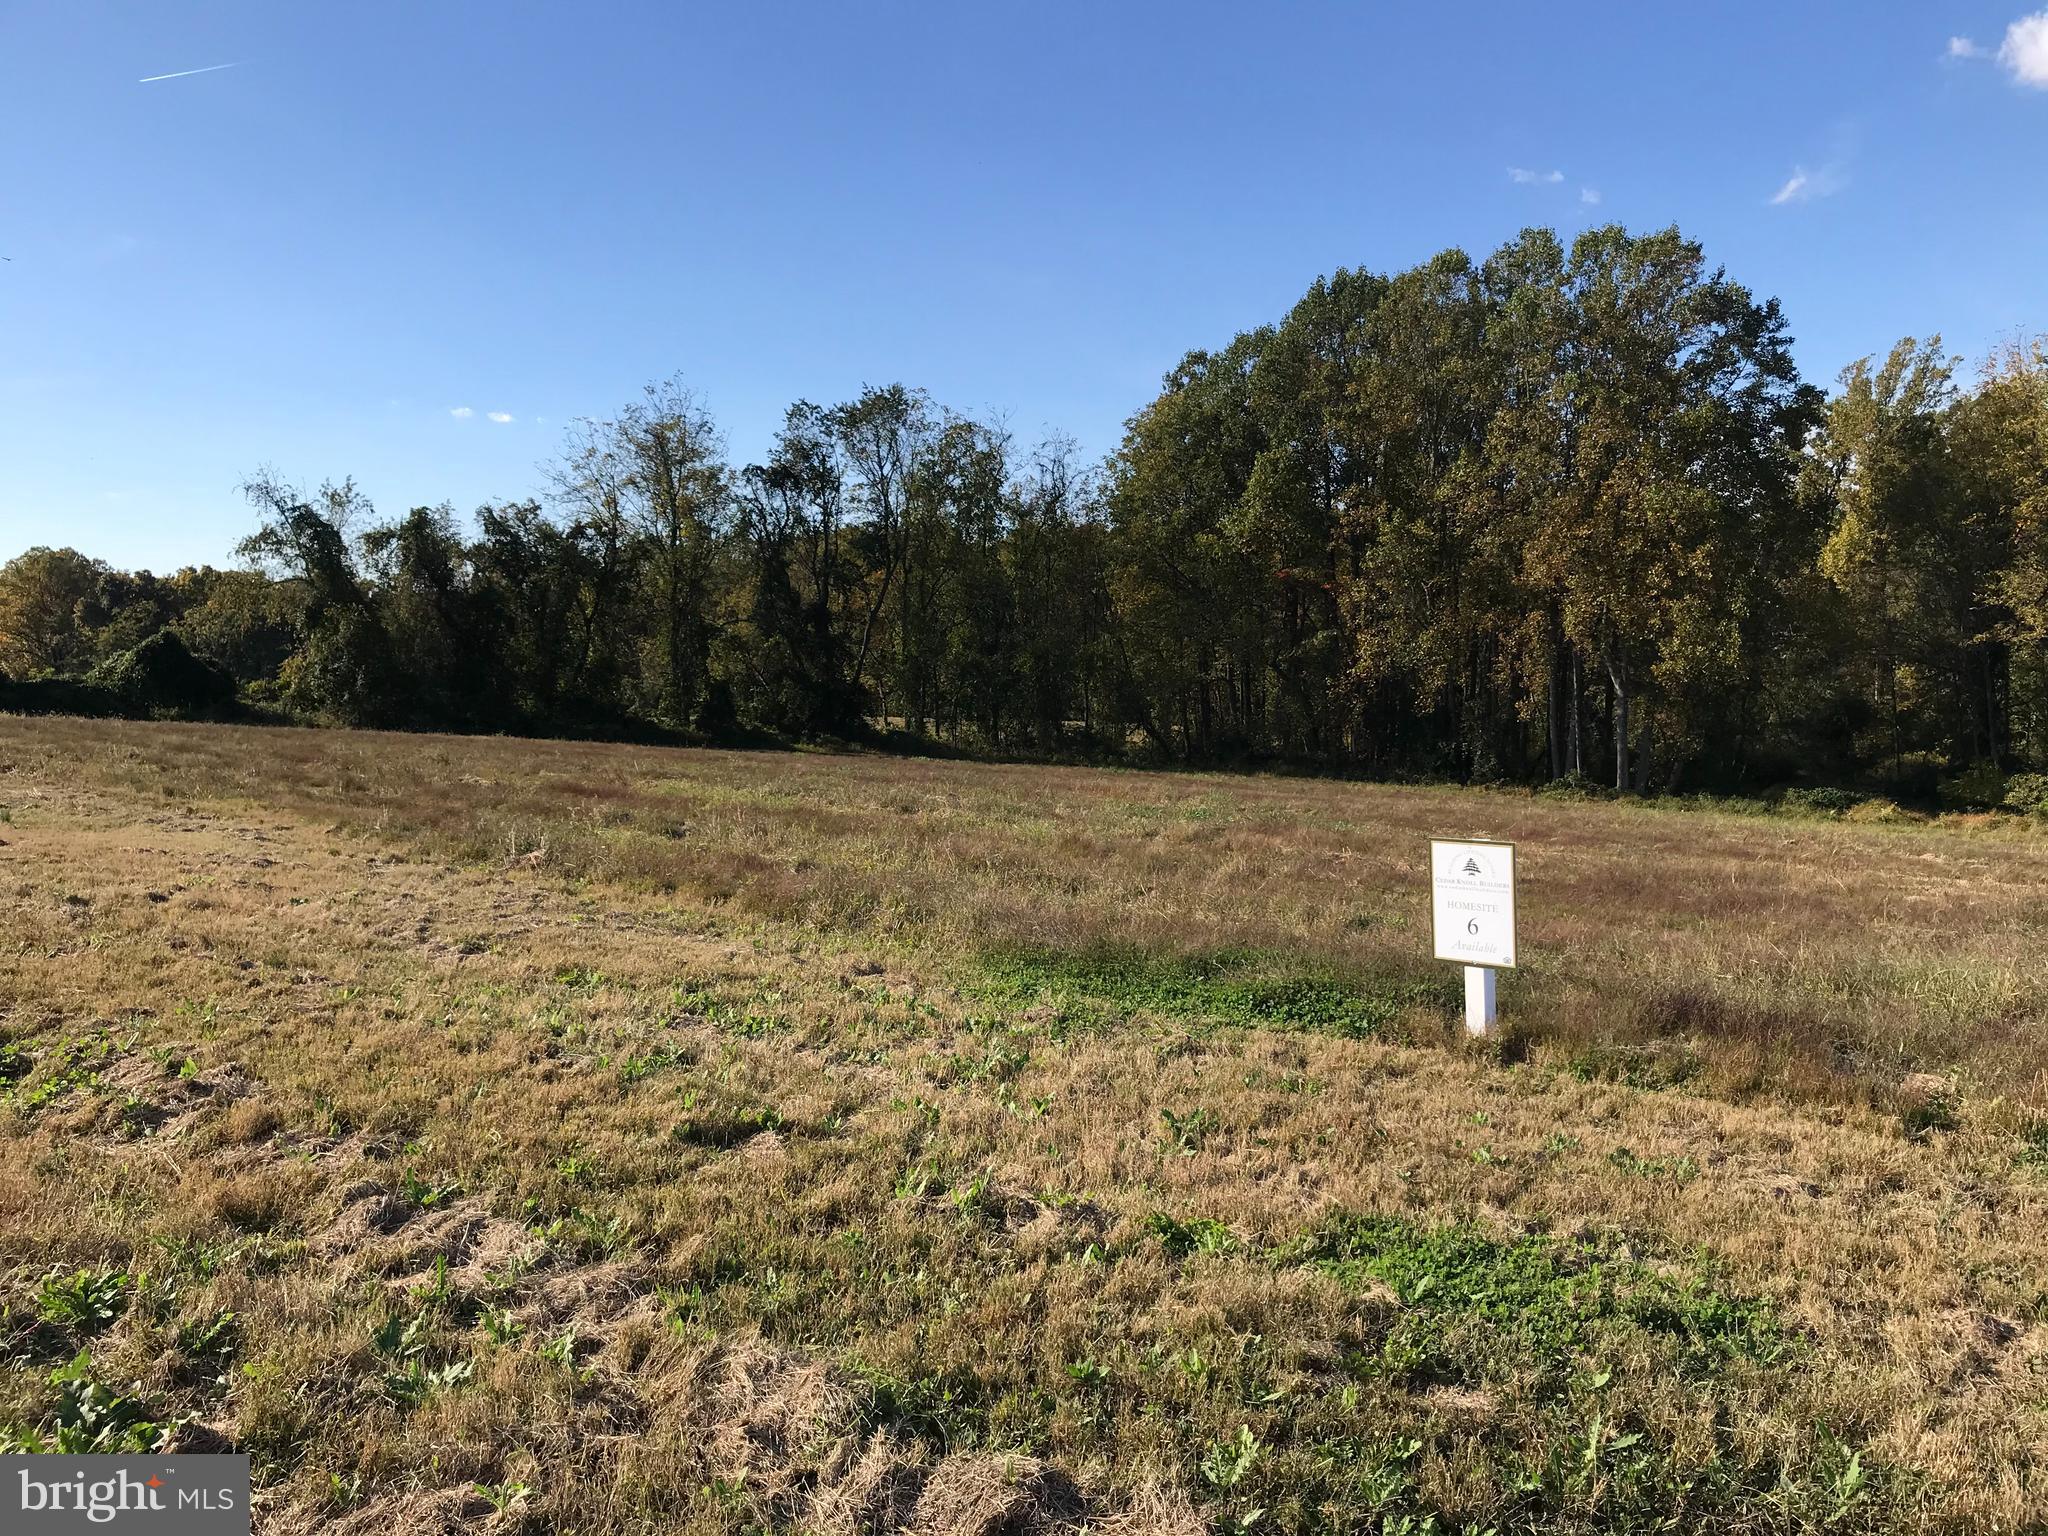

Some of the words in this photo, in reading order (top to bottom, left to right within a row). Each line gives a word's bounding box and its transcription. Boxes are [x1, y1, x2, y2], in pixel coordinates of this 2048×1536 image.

[1447, 900, 1499, 913] HOMESITE
[1467, 917, 1479, 936] 6
[1451, 940, 1498, 954] Available
